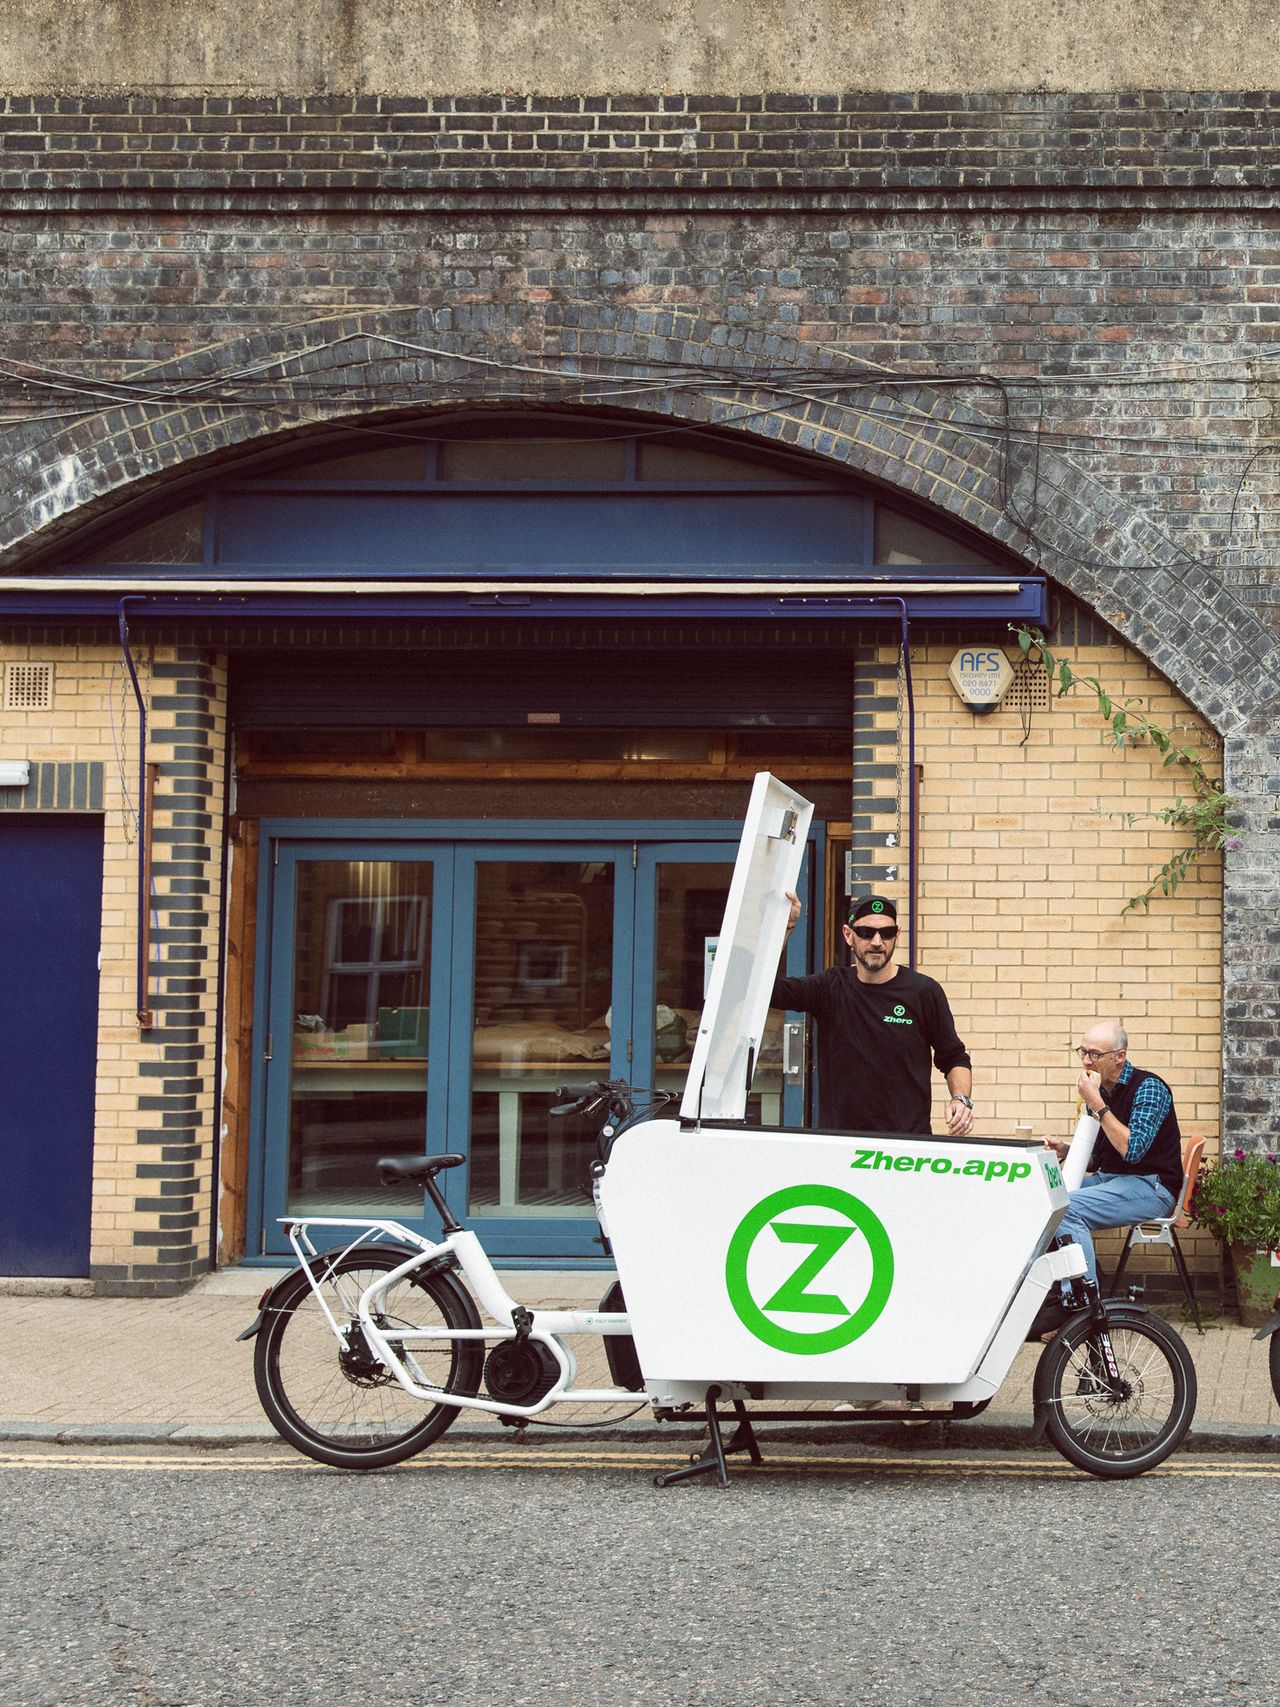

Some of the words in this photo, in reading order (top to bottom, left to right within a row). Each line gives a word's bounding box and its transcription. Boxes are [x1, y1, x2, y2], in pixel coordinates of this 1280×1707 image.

[960, 652, 1000, 672] AFS
[969, 688, 991, 696] 9000
[883, 1015, 913, 1025] Zhero
[850, 1149, 1032, 1184] Zhero.app
